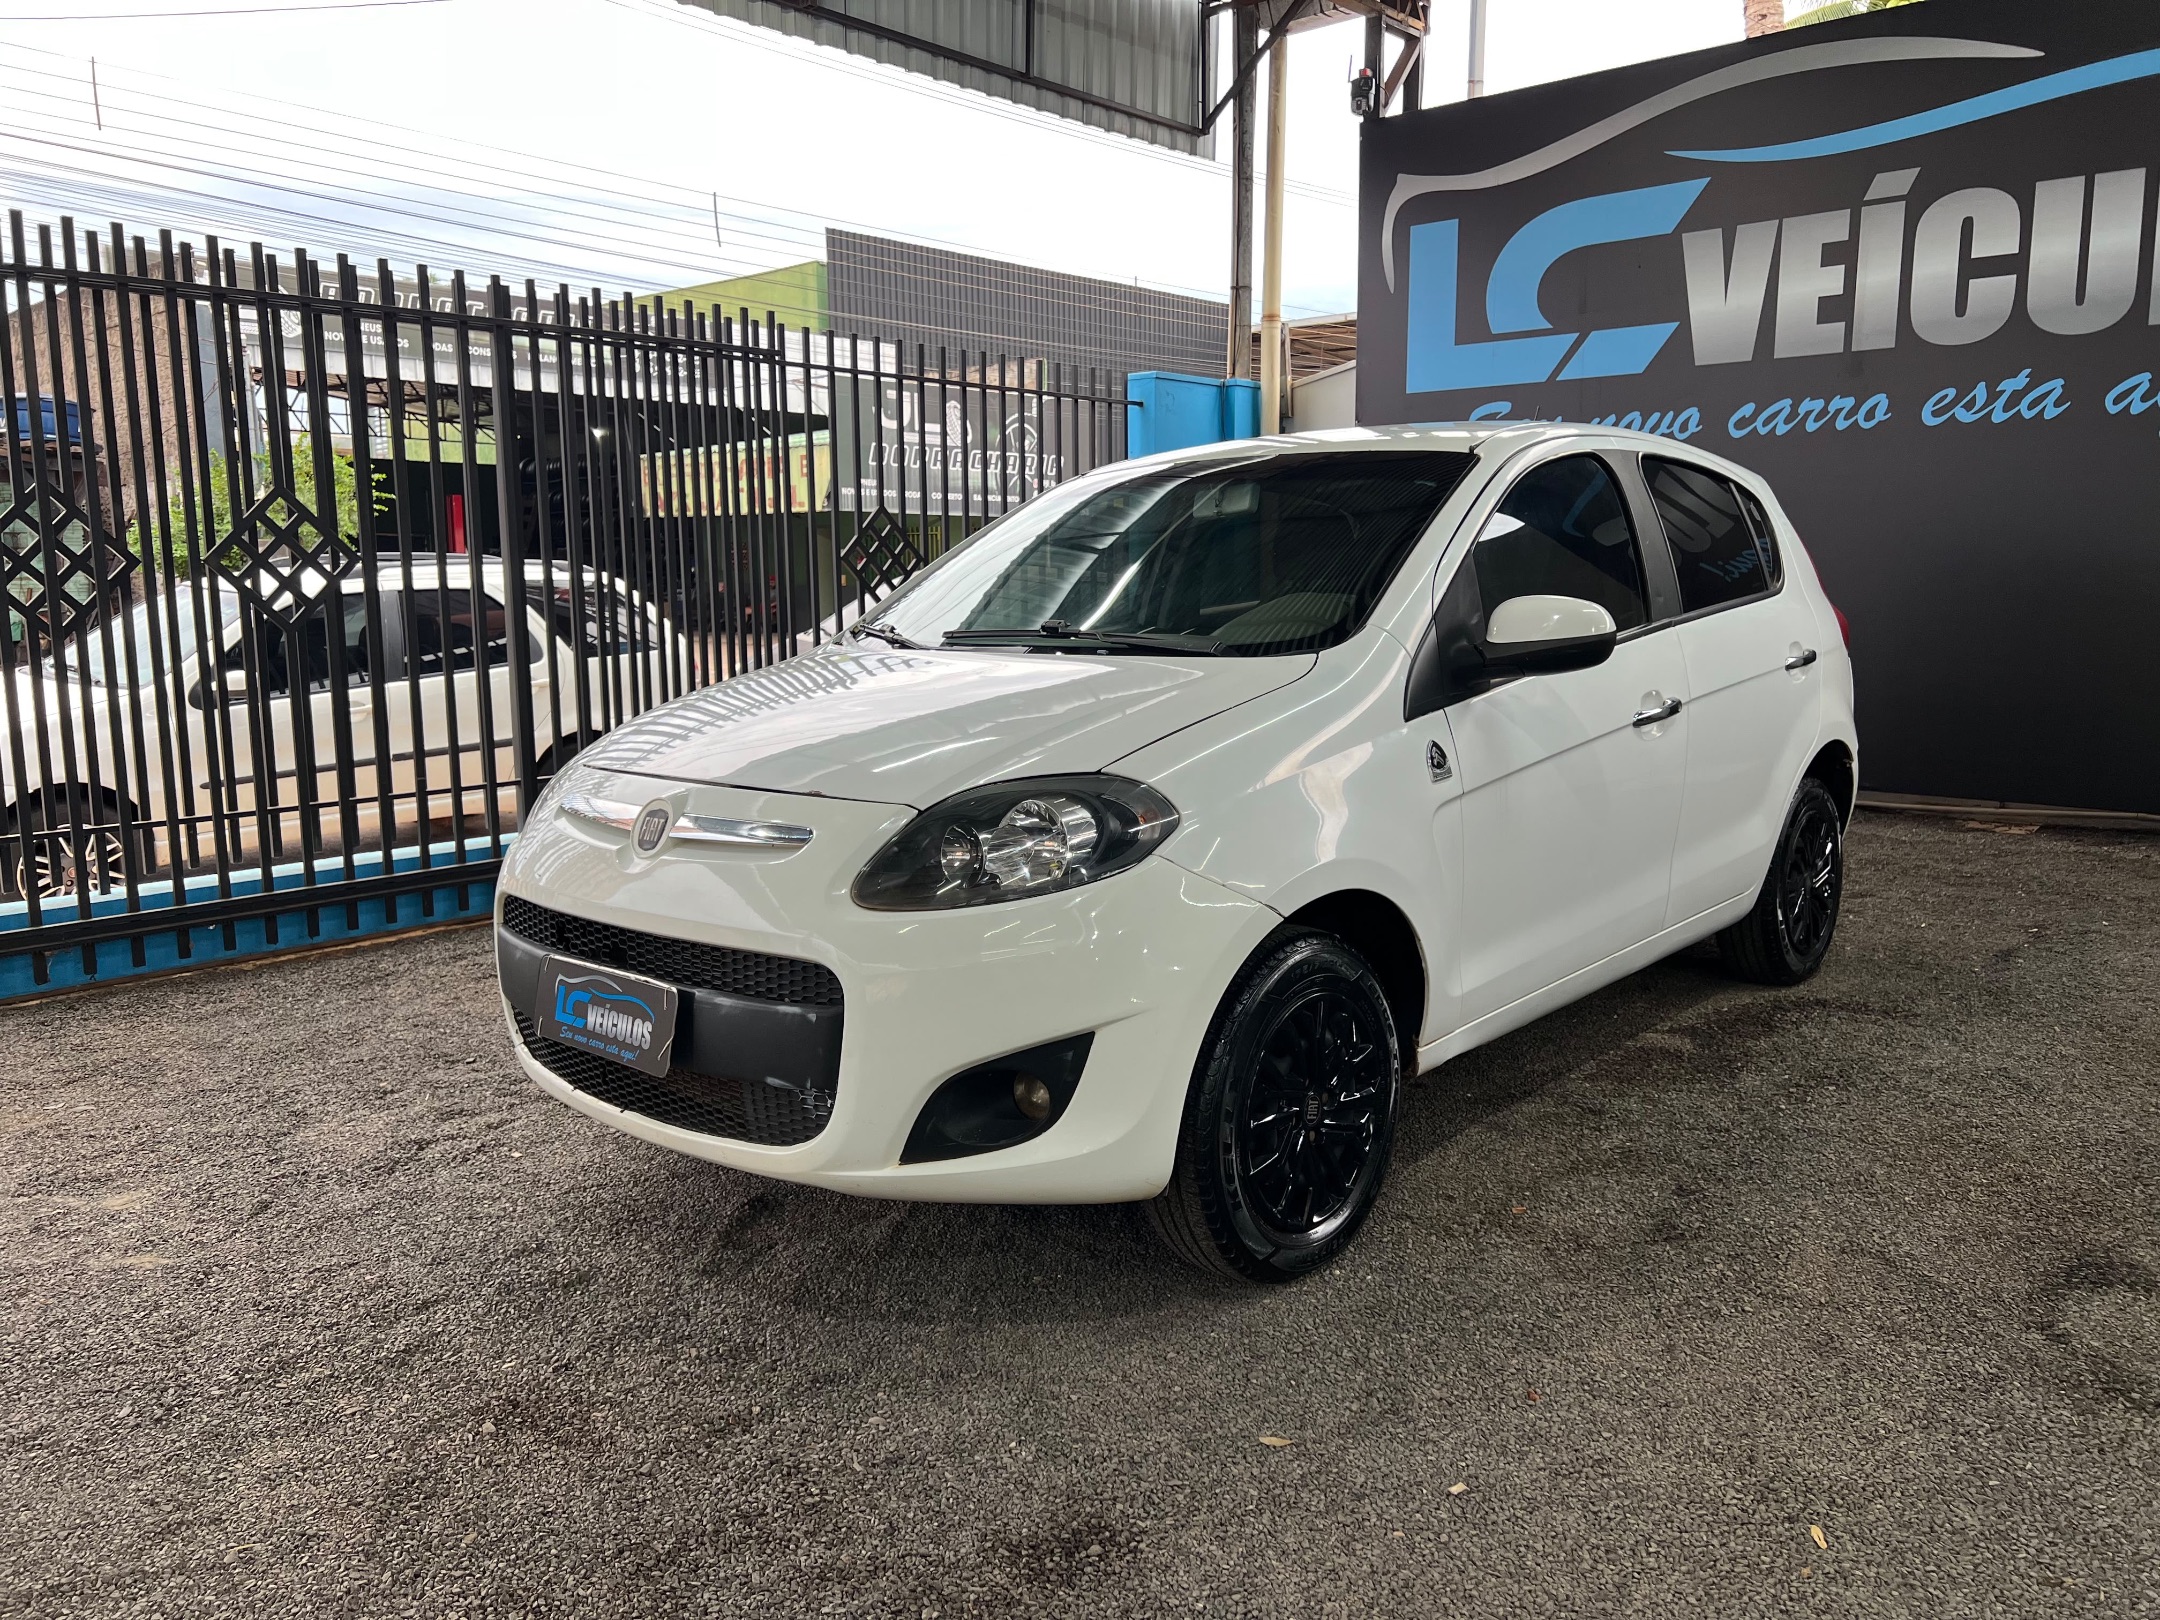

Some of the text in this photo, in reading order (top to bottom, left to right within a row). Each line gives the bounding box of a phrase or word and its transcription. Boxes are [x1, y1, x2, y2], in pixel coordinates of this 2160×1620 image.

[1406, 167, 2160, 394] LC VEÍCU
[1728, 393, 1891, 438] carro
[1921, 368, 2071, 426] esta
[640, 816, 665, 842] FIAT
[555, 985, 653, 1050] LC VEÍCULOS
[560, 1026, 574, 1038] Seu
[574, 1033, 588, 1044] novo
[588, 1037, 605, 1050] carro
[620, 1049, 640, 1062] aqui!
[1306, 1100, 1319, 1119] FIAT
